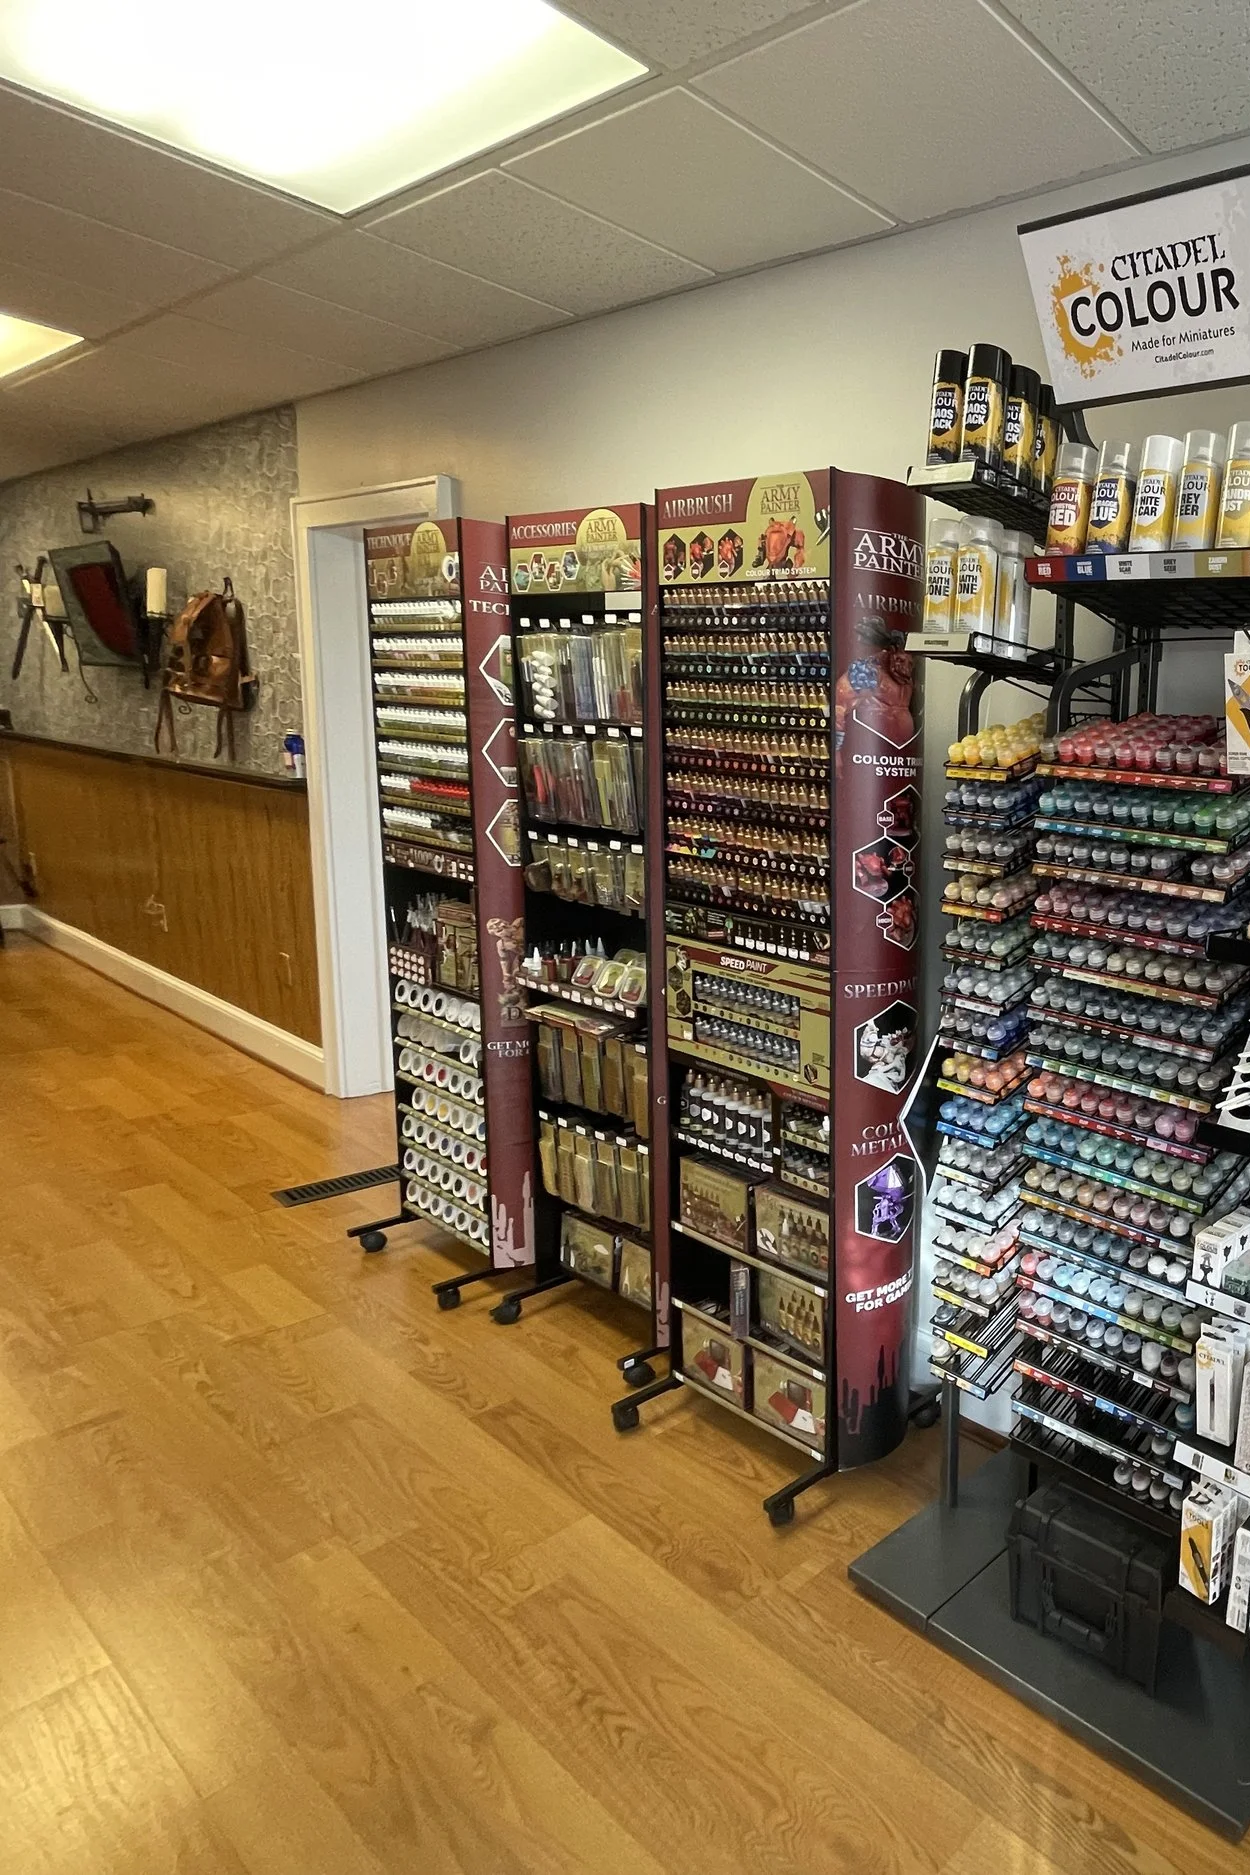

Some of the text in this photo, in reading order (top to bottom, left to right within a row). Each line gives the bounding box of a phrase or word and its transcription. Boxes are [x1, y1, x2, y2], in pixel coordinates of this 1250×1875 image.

[1110, 233, 1226, 282] CITADEL
[1070, 267, 1240, 337] COLOUR
[1131, 323, 1236, 352] Made for Miniatures
[1154, 348, 1215, 363] CitadelColour.com
[760, 486, 800, 503] ARMY
[1140, 495, 1160, 506] HITE
[1180, 493, 1200, 506] REY
[663, 493, 734, 520] AIRBRUSH
[760, 499, 800, 513] PAINTER
[1137, 506, 1158, 517] CAR
[587, 518, 618, 534] ARMY
[1049, 512, 1077, 527] RED
[511, 521, 577, 541] ACCESSORIES
[892, 533, 909, 541] THE
[854, 532, 924, 566] ARMY
[745, 567, 771, 578] COLOUR
[790, 566, 817, 576] SYSTEM
[1037, 567, 1052, 576] RED
[1076, 565, 1093, 574] BLUE
[926, 584, 949, 597] ONE
[958, 583, 978, 595] ONE
[852, 754, 905, 766] COLOUR
[875, 766, 917, 777] SYSTEM
[719, 955, 768, 974] SPEED PAINT
[486, 1041, 513, 1051] GET
[845, 1276, 907, 1304] GET MORE
[855, 1297, 884, 1313] FOR
